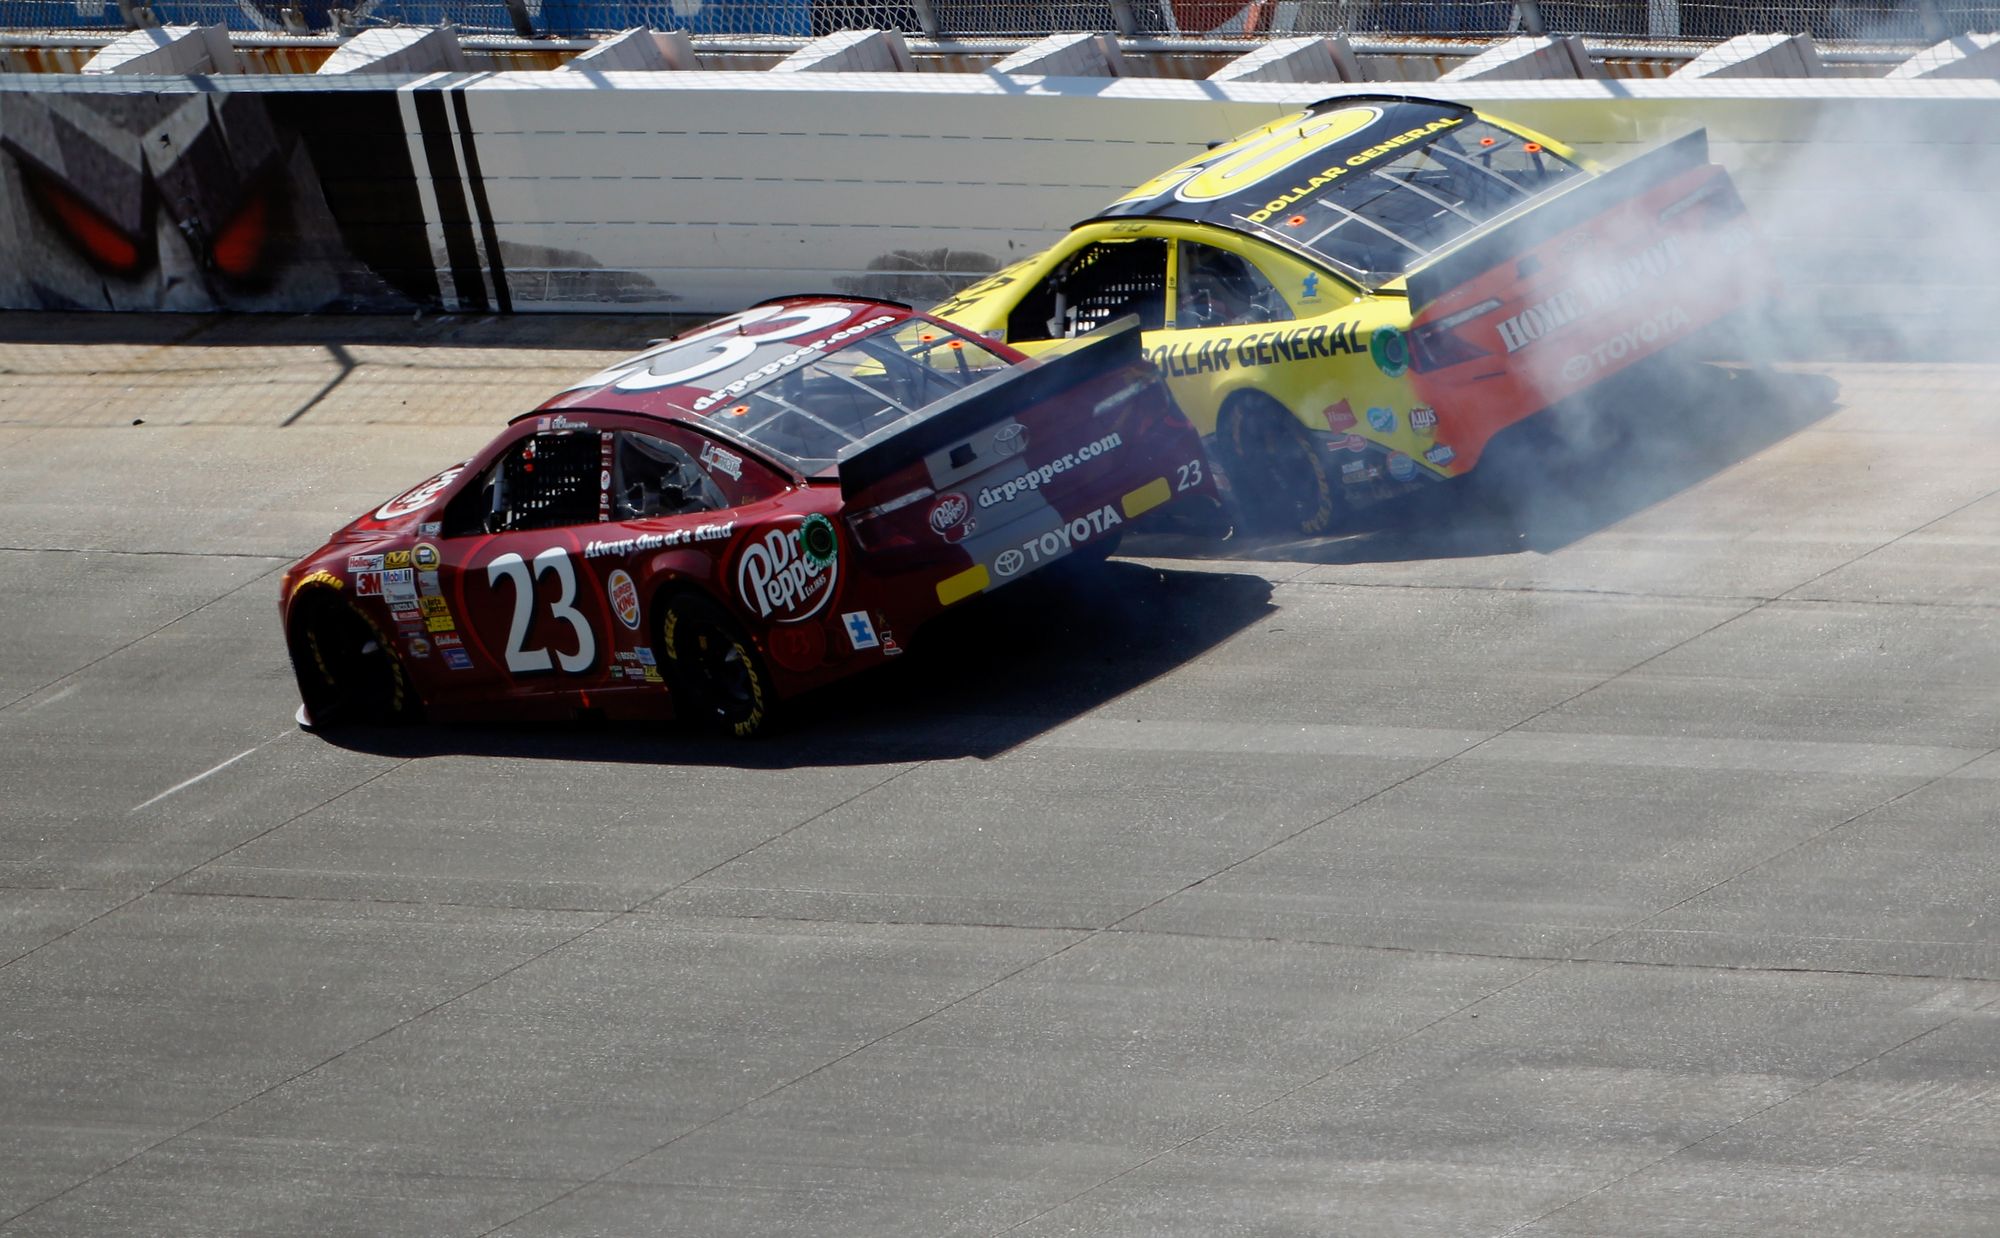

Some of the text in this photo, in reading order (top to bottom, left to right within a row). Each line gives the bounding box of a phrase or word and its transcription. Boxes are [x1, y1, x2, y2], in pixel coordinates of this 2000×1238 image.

[1247, 116, 1464, 223] DOLLAR GENERAL
[1497, 287, 1584, 352] HOME
[1592, 305, 1691, 367] TOYOTA
[693, 315, 896, 411] drpepper.com
[1237, 320, 1368, 368] GENERAL
[978, 432, 1122, 508] drpepper.com
[1177, 459, 1203, 492] 23
[584, 521, 734, 558] Always One of a Kind
[765, 529, 800, 573] Dr
[1023, 504, 1123, 562] TOYOTA
[358, 573, 382, 595] 3M
[384, 569, 404, 584] Mobil
[613, 583, 632, 598] BURGER
[487, 547, 595, 672] 23
[617, 592, 636, 613] KING
